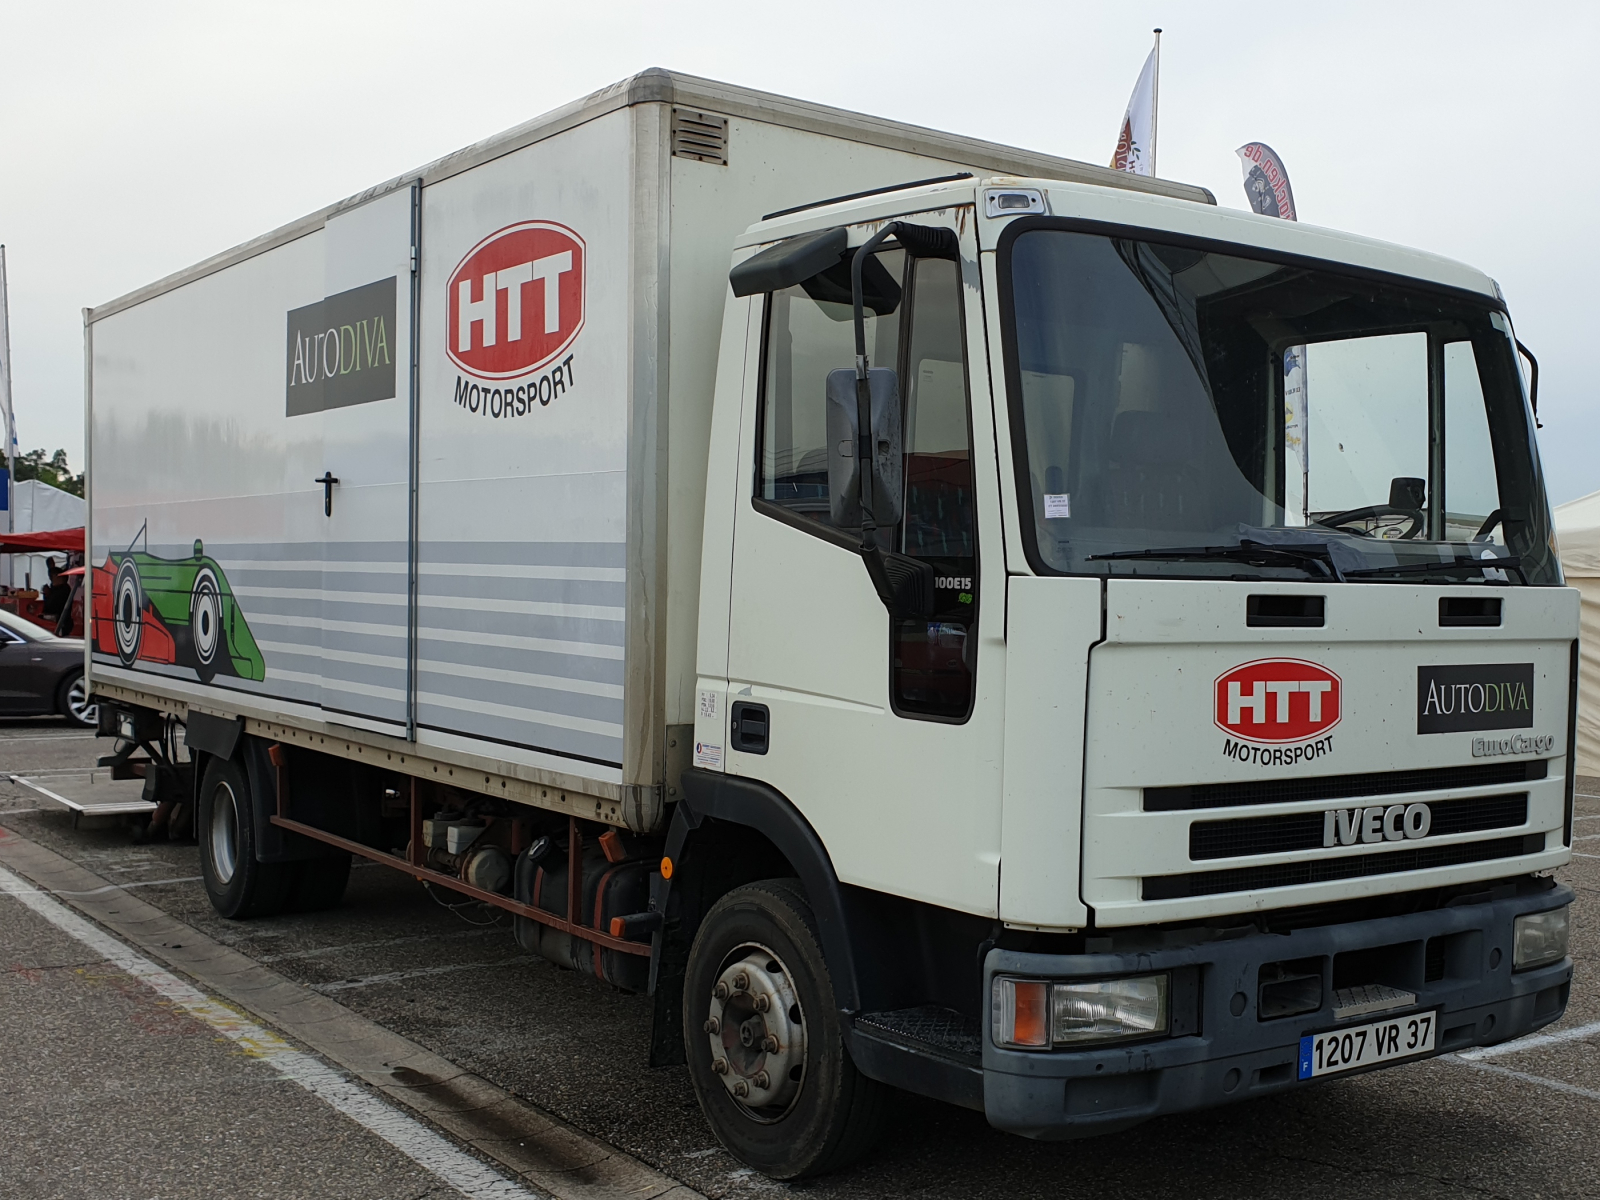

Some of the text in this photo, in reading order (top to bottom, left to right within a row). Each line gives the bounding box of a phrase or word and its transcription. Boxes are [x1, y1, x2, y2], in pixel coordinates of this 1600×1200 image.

[458, 249, 573, 353] HTT
[453, 353, 574, 419] MOTORSPORT
[934, 577, 972, 589] 100E15
[1227, 680, 1332, 725] HTT
[1422, 678, 1530, 716] AUTODIVA
[1222, 734, 1334, 767] MOTORSPORT
[1472, 733, 1555, 758] EuroCargo
[1323, 802, 1432, 848] IVECO
[1315, 1016, 1432, 1069] 1207 VR 37
[1302, 1061, 1309, 1072] F
